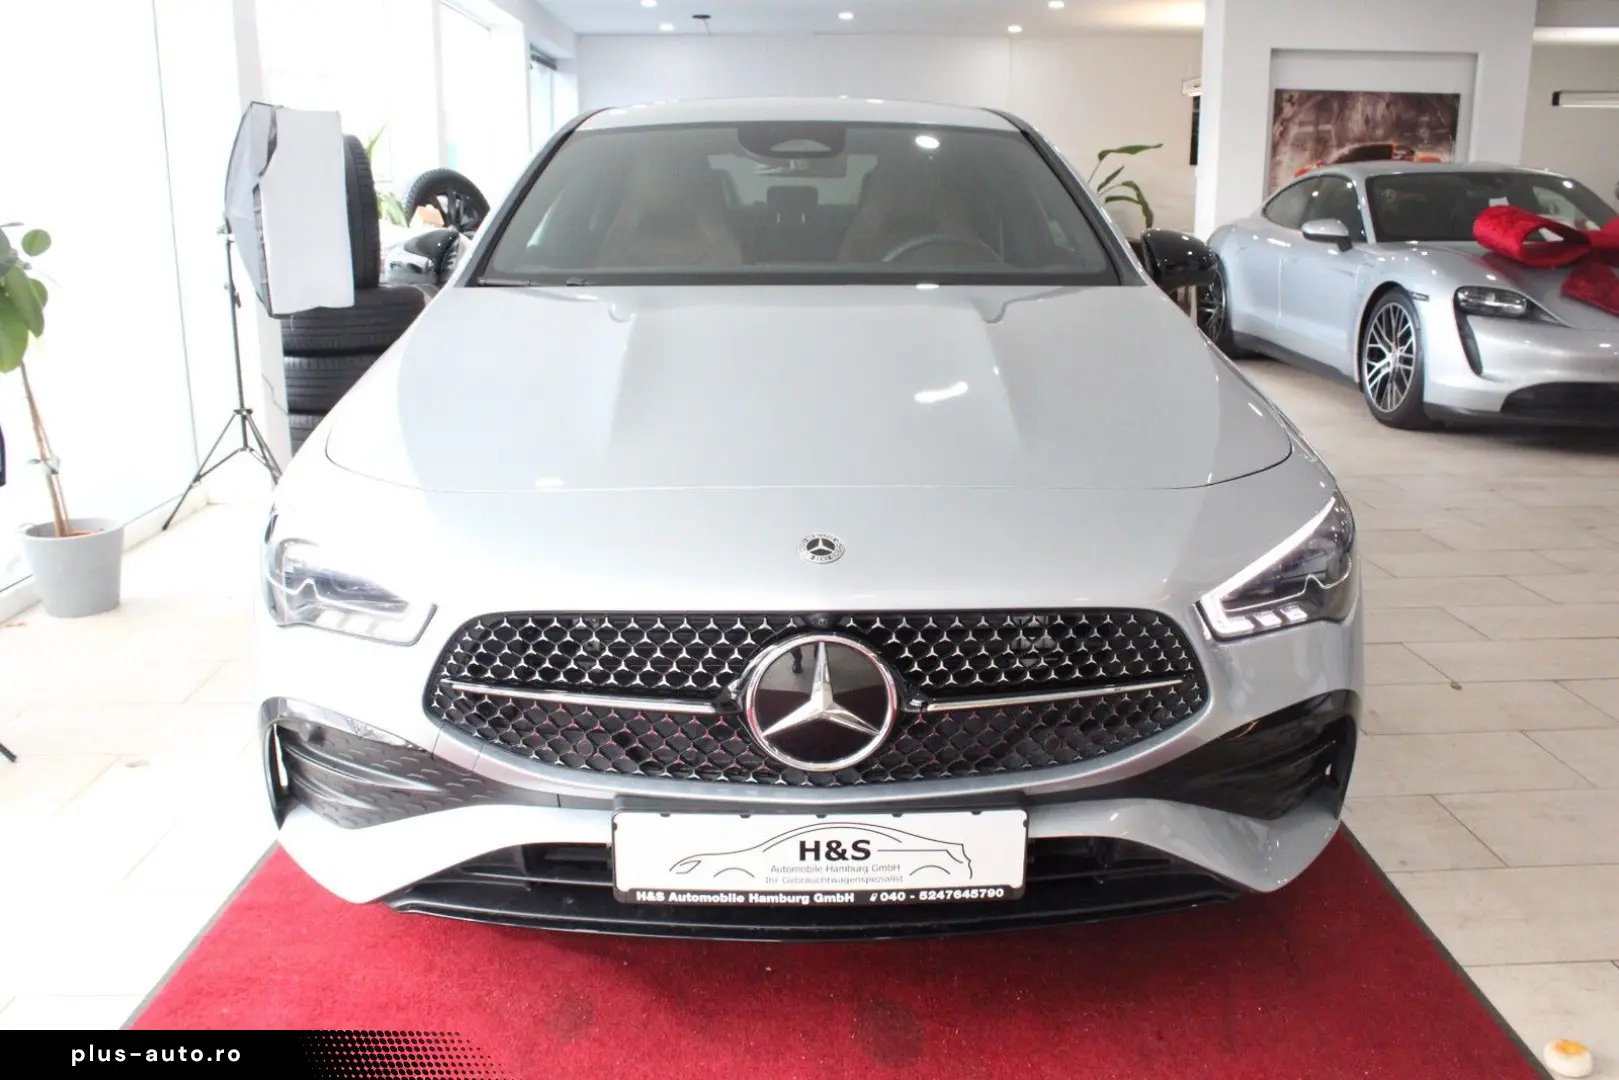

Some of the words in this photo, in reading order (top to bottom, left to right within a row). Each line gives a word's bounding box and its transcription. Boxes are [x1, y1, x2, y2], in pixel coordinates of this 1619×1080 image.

[799, 839, 871, 861] H&S
[770, 864, 824, 874] Automobile
[826, 863, 869, 875] Hamburg
[871, 863, 901, 873] GmbH
[636, 890, 666, 902] H&S
[668, 891, 746, 903] Automobile
[749, 893, 810, 905] Hamburg
[813, 891, 855, 903] GmbH
[879, 891, 907, 902] 040
[918, 887, 1005, 901] 5247645790
